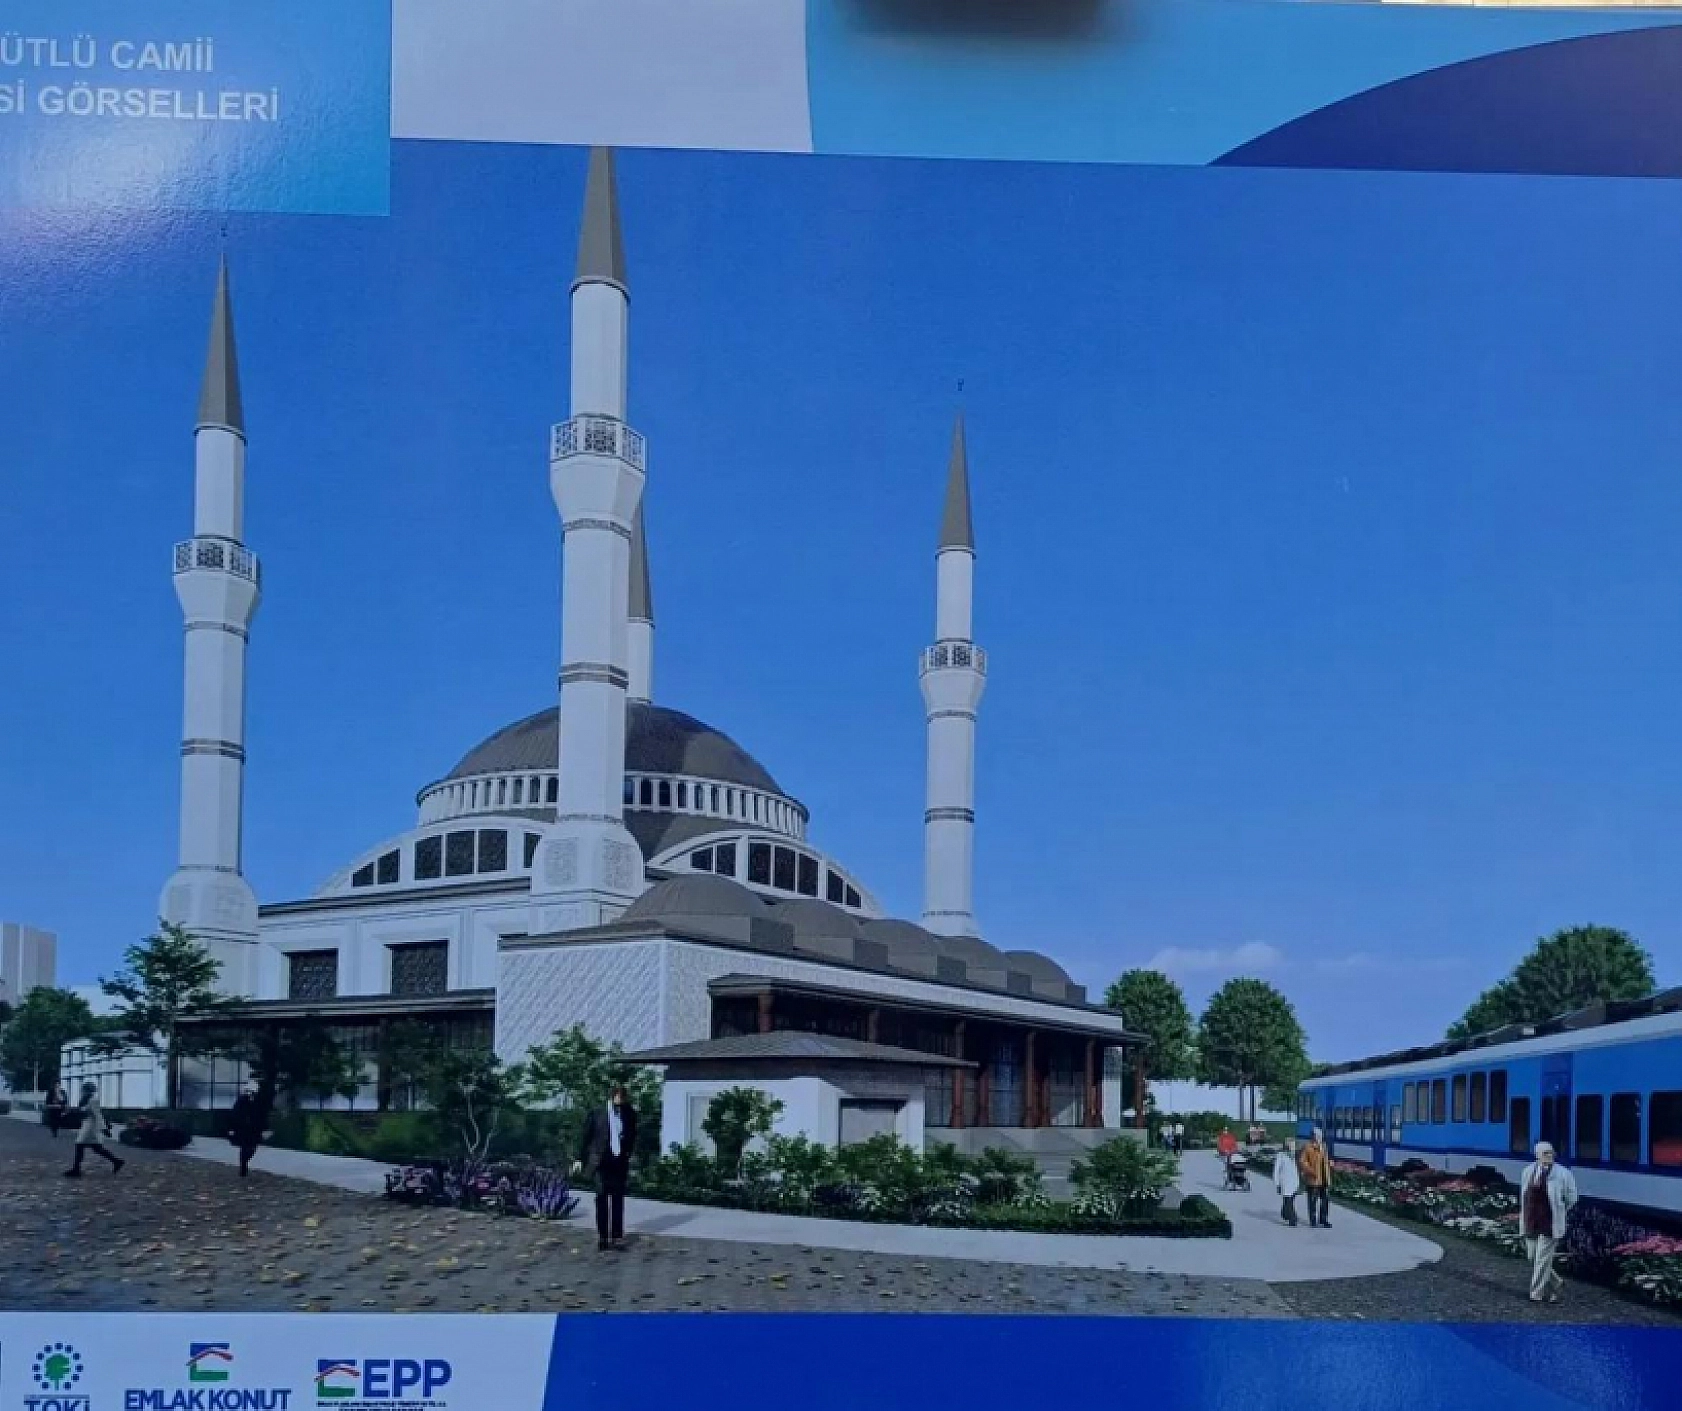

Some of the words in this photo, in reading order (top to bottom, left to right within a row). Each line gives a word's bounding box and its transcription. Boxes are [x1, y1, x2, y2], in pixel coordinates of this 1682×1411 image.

[1, 32, 96, 68] ÜTLÜ
[111, 37, 214, 71] CAMİİ
[39, 81, 279, 122] GÖRSELLERİ
[363, 1359, 452, 1397] EPP
[125, 1389, 204, 1410] EMLAK
[210, 1389, 292, 1410] KONUT
